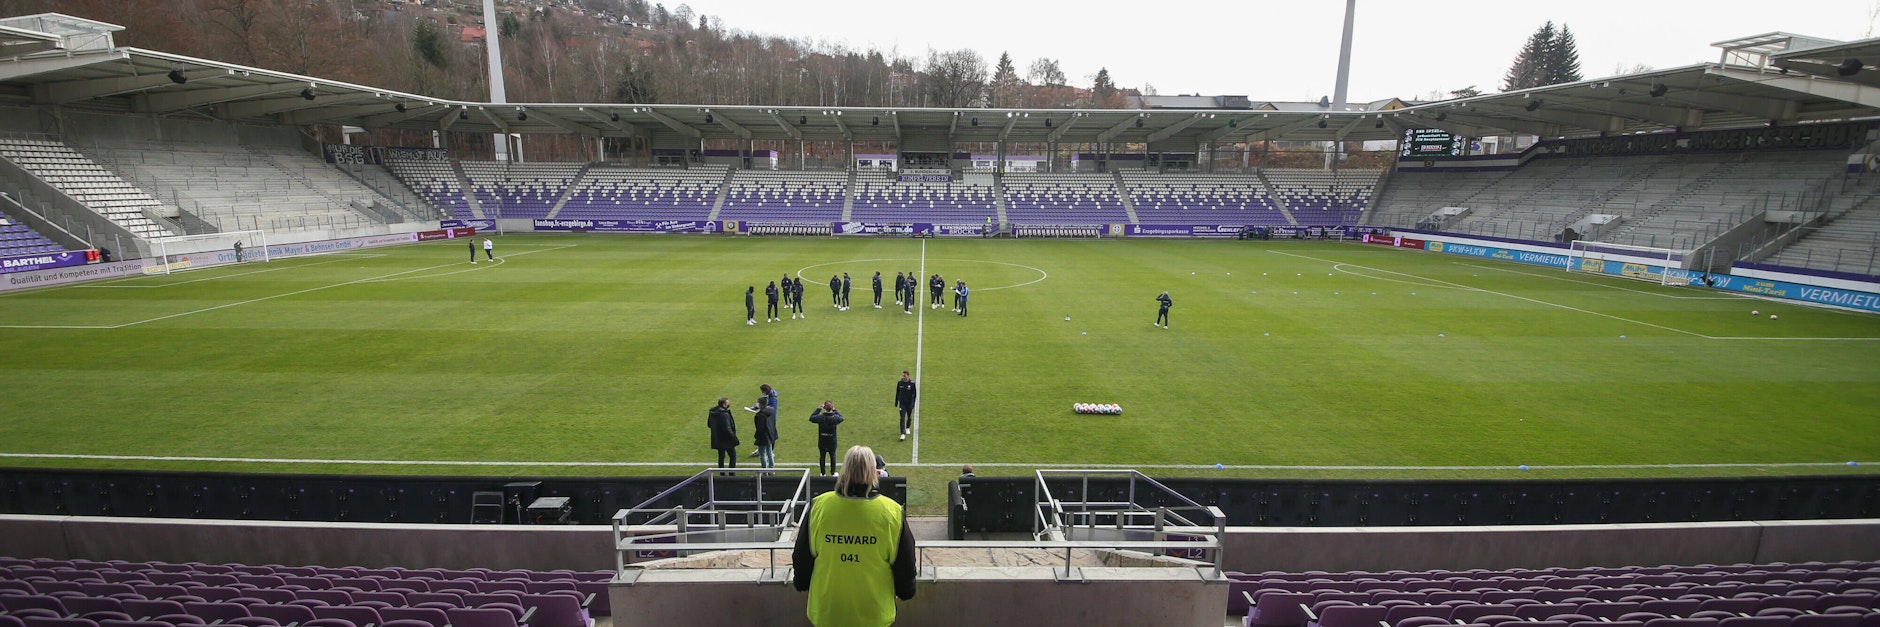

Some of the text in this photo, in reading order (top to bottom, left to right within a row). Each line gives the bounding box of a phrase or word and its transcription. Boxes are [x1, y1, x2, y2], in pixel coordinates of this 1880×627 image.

[335, 152, 365, 165] BSG
[427, 149, 449, 160] AUE
[284, 245, 302, 257] Mayer
[335, 240, 352, 249] GmbH
[4, 256, 56, 268] BARTHEL
[1519, 252, 1575, 267] VERMIETUNG
[11, 275, 42, 285] Qualität
[44, 273, 58, 282] und
[60, 268, 98, 279] Kompetenz
[100, 265, 111, 273] mit
[1742, 284, 1787, 296] Mini-Tarif
[825, 534, 877, 545] STEWARD
[840, 553, 860, 563] 041
